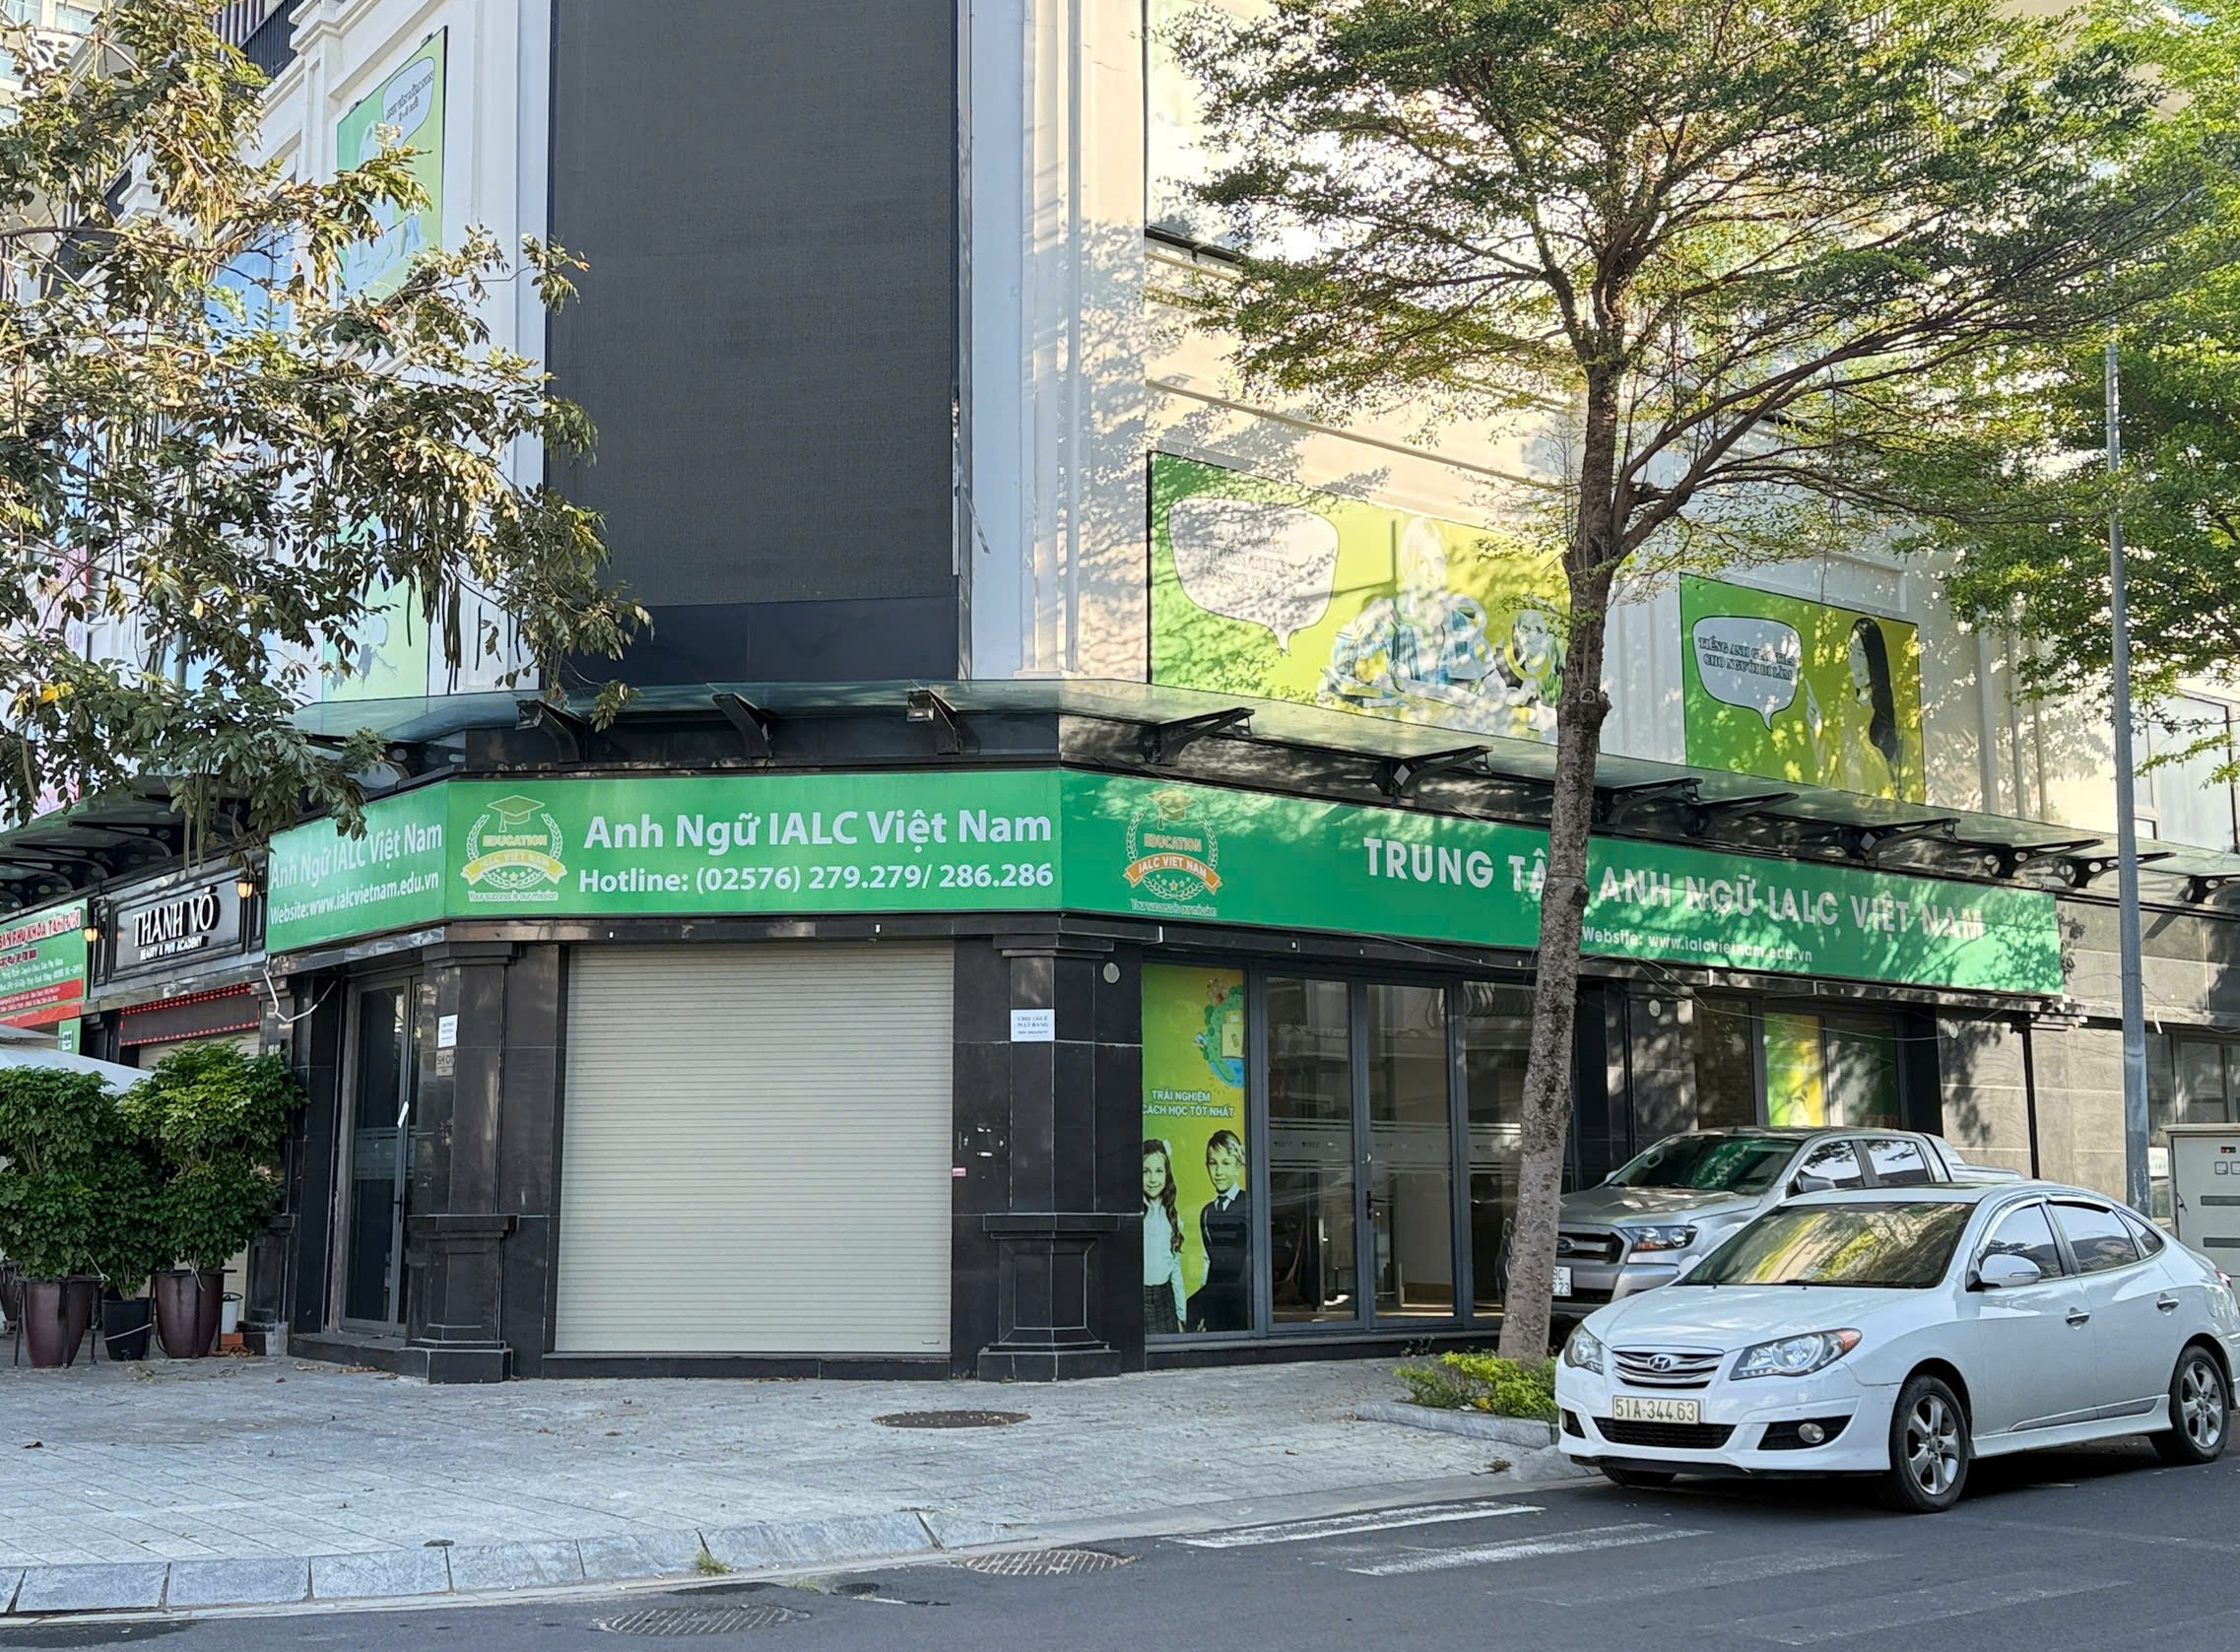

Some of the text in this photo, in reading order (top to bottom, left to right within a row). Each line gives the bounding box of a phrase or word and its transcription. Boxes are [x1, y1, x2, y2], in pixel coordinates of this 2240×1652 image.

[483, 834, 548, 846] EDUCATION
[583, 809, 1051, 856] Anh Ngữ IALC Việt Nam
[269, 853, 296, 891] Anh
[300, 845, 331, 888] Ngữ
[369, 826, 400, 869] Việt
[404, 823, 442, 855] Nam
[1138, 856, 1207, 879] IALC VIET NAM
[579, 862, 1054, 894] Hotline: (02576) 279.279/ 286.286
[1363, 837, 1985, 942] TRUNG TÂ ANH NGỮ IALC VIỆT NAM
[133, 901, 184, 948] THANH
[1582, 926, 1643, 947] Website:
[1175, 1090, 1211, 1102] NGHIỆM
[1168, 1104, 1188, 1117] HỌC
[1615, 1399, 1695, 1421] 51A-344.63
